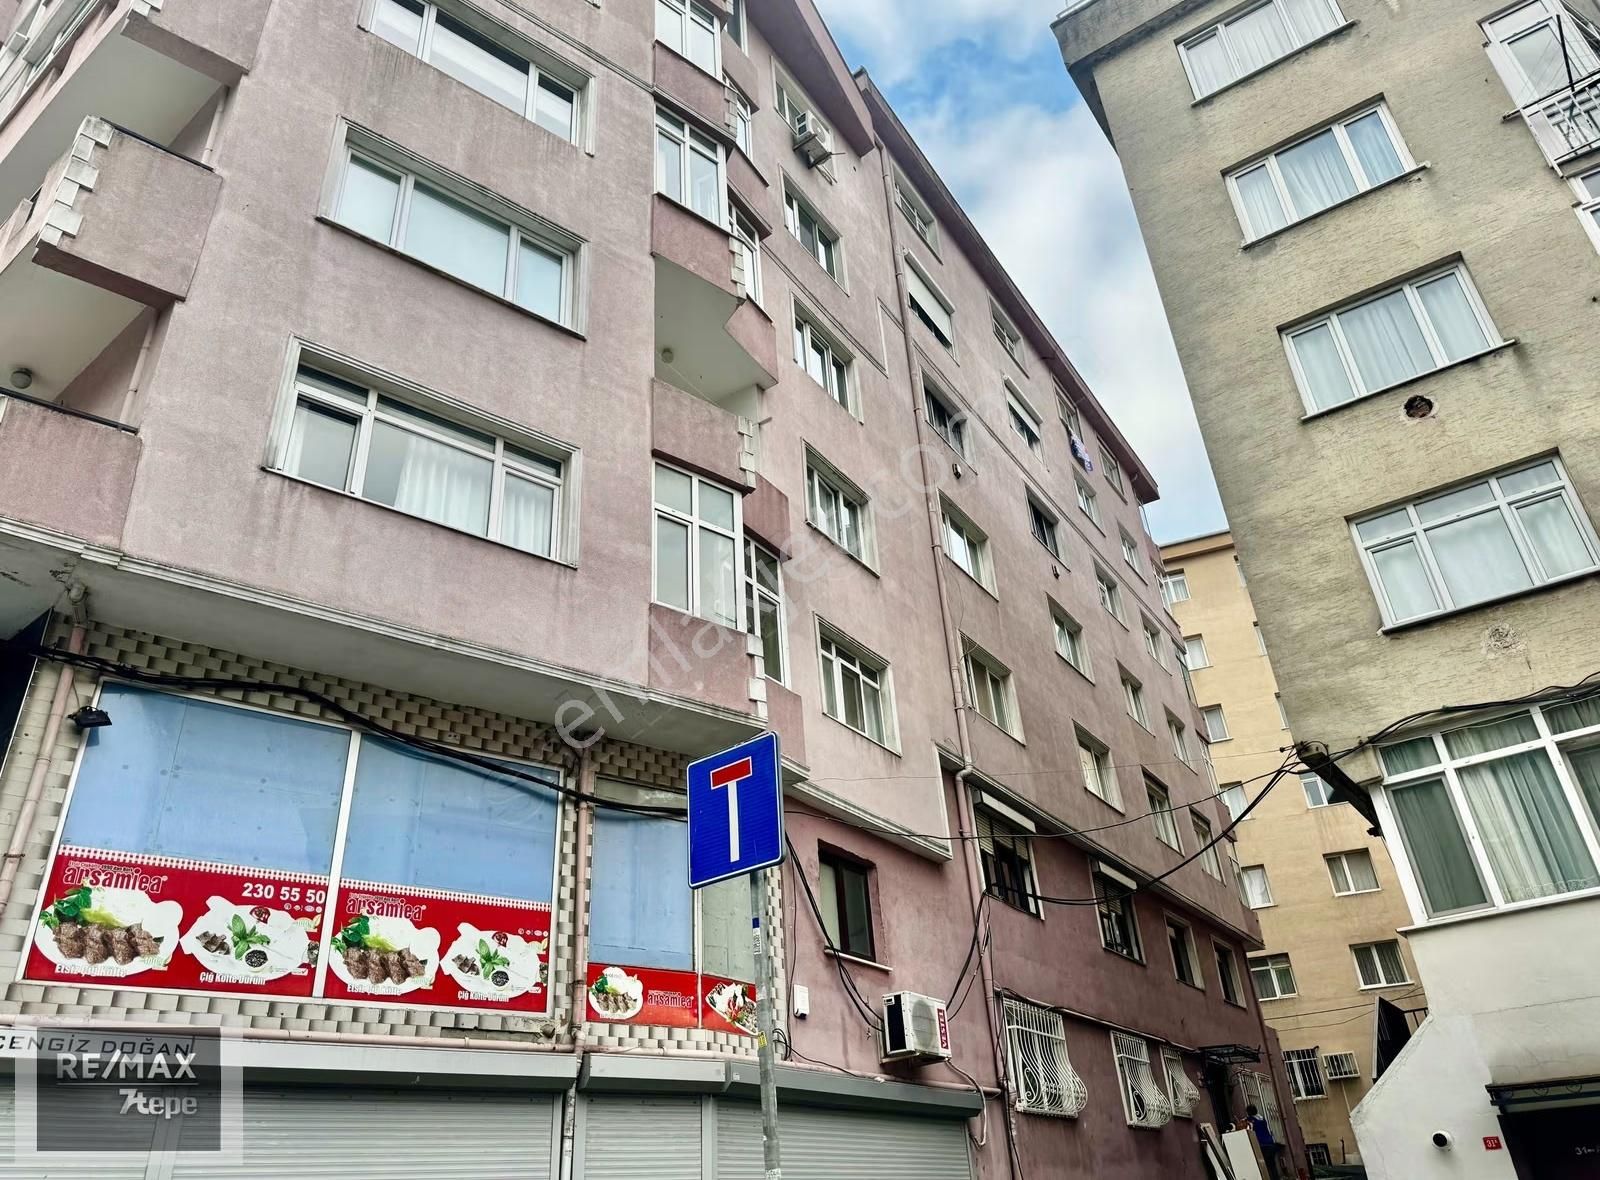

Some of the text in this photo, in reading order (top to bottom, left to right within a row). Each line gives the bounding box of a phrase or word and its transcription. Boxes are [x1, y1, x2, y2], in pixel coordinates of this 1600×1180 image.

[241, 882, 326, 904] 230 55 50
[101, 1038, 190, 1056] DOĞAN
